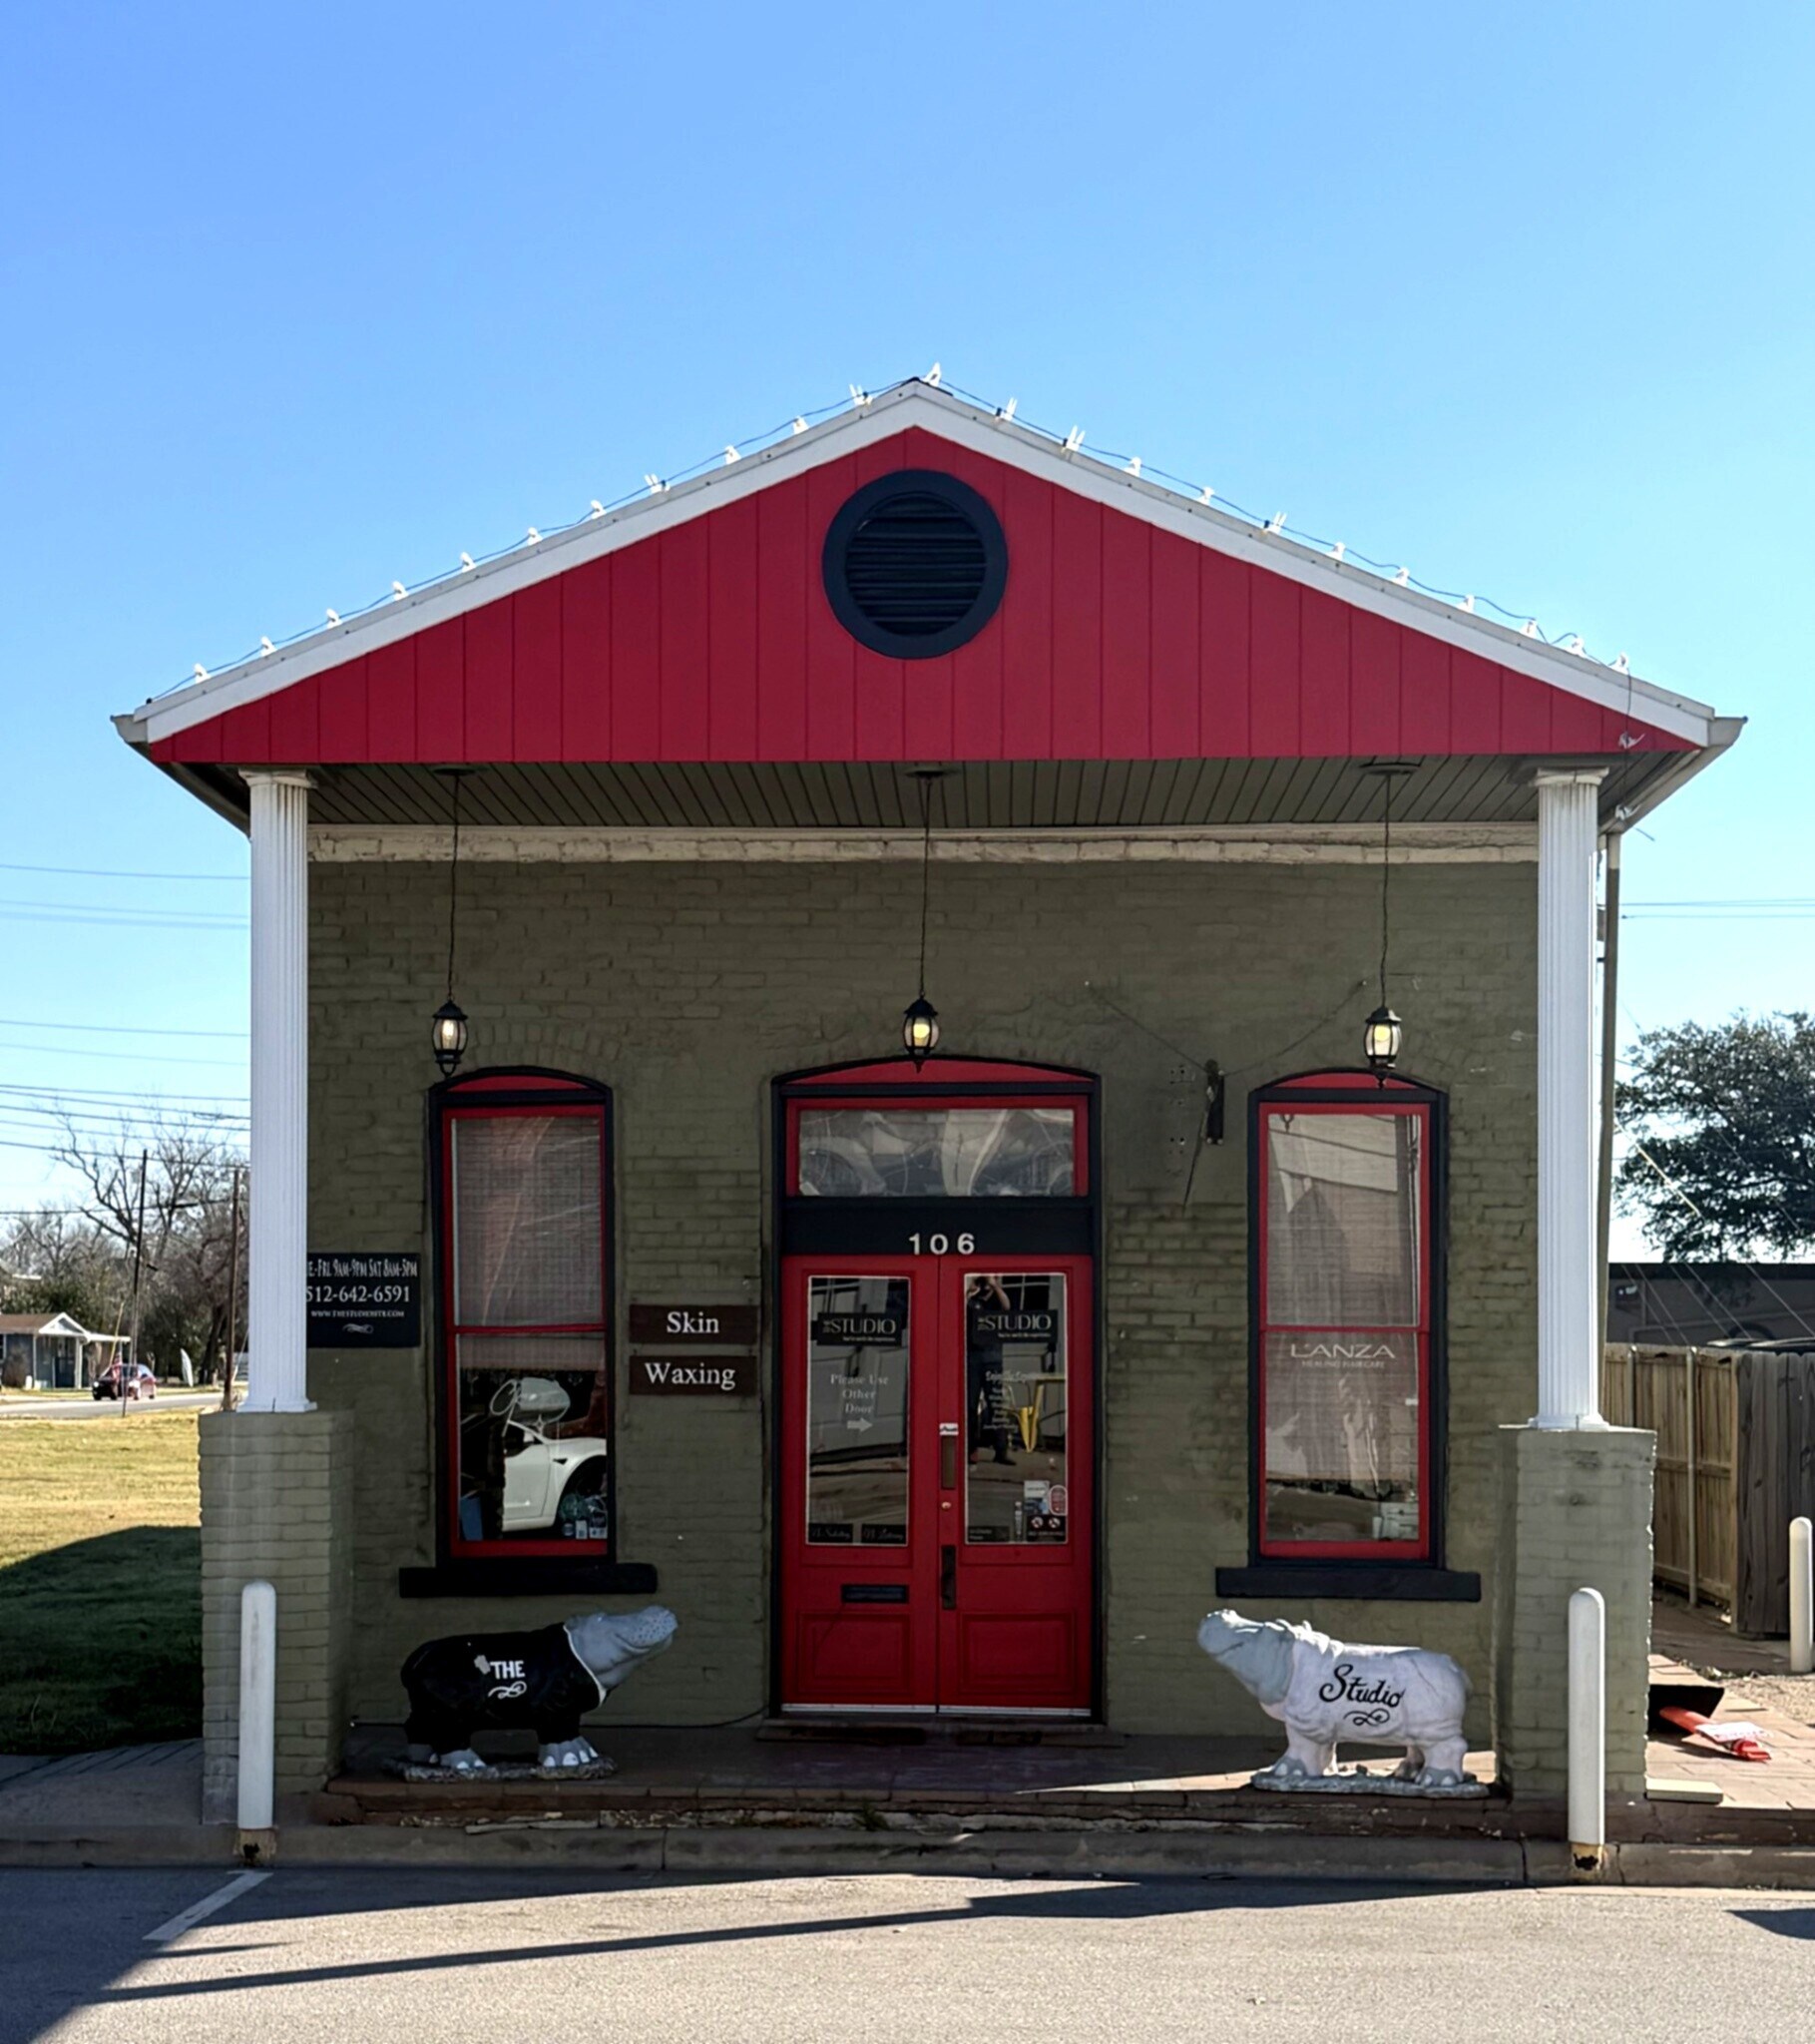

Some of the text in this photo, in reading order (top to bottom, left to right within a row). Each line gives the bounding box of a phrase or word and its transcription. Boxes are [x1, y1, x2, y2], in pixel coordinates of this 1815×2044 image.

[909, 1233, 975, 1256] 106
[306, 1284, 410, 1302] 512-642-6591
[667, 1311, 719, 1333] Skin
[829, 1318, 897, 1334] STUDIO
[986, 1313, 1053, 1330] STUDIO
[645, 1362, 736, 1391] Waxing
[830, 1373, 865, 1385] Please
[842, 1388, 876, 1399] Other
[845, 1402, 873, 1413] Door
[490, 1660, 526, 1680] THE
[1319, 1664, 1407, 1708] Studio
